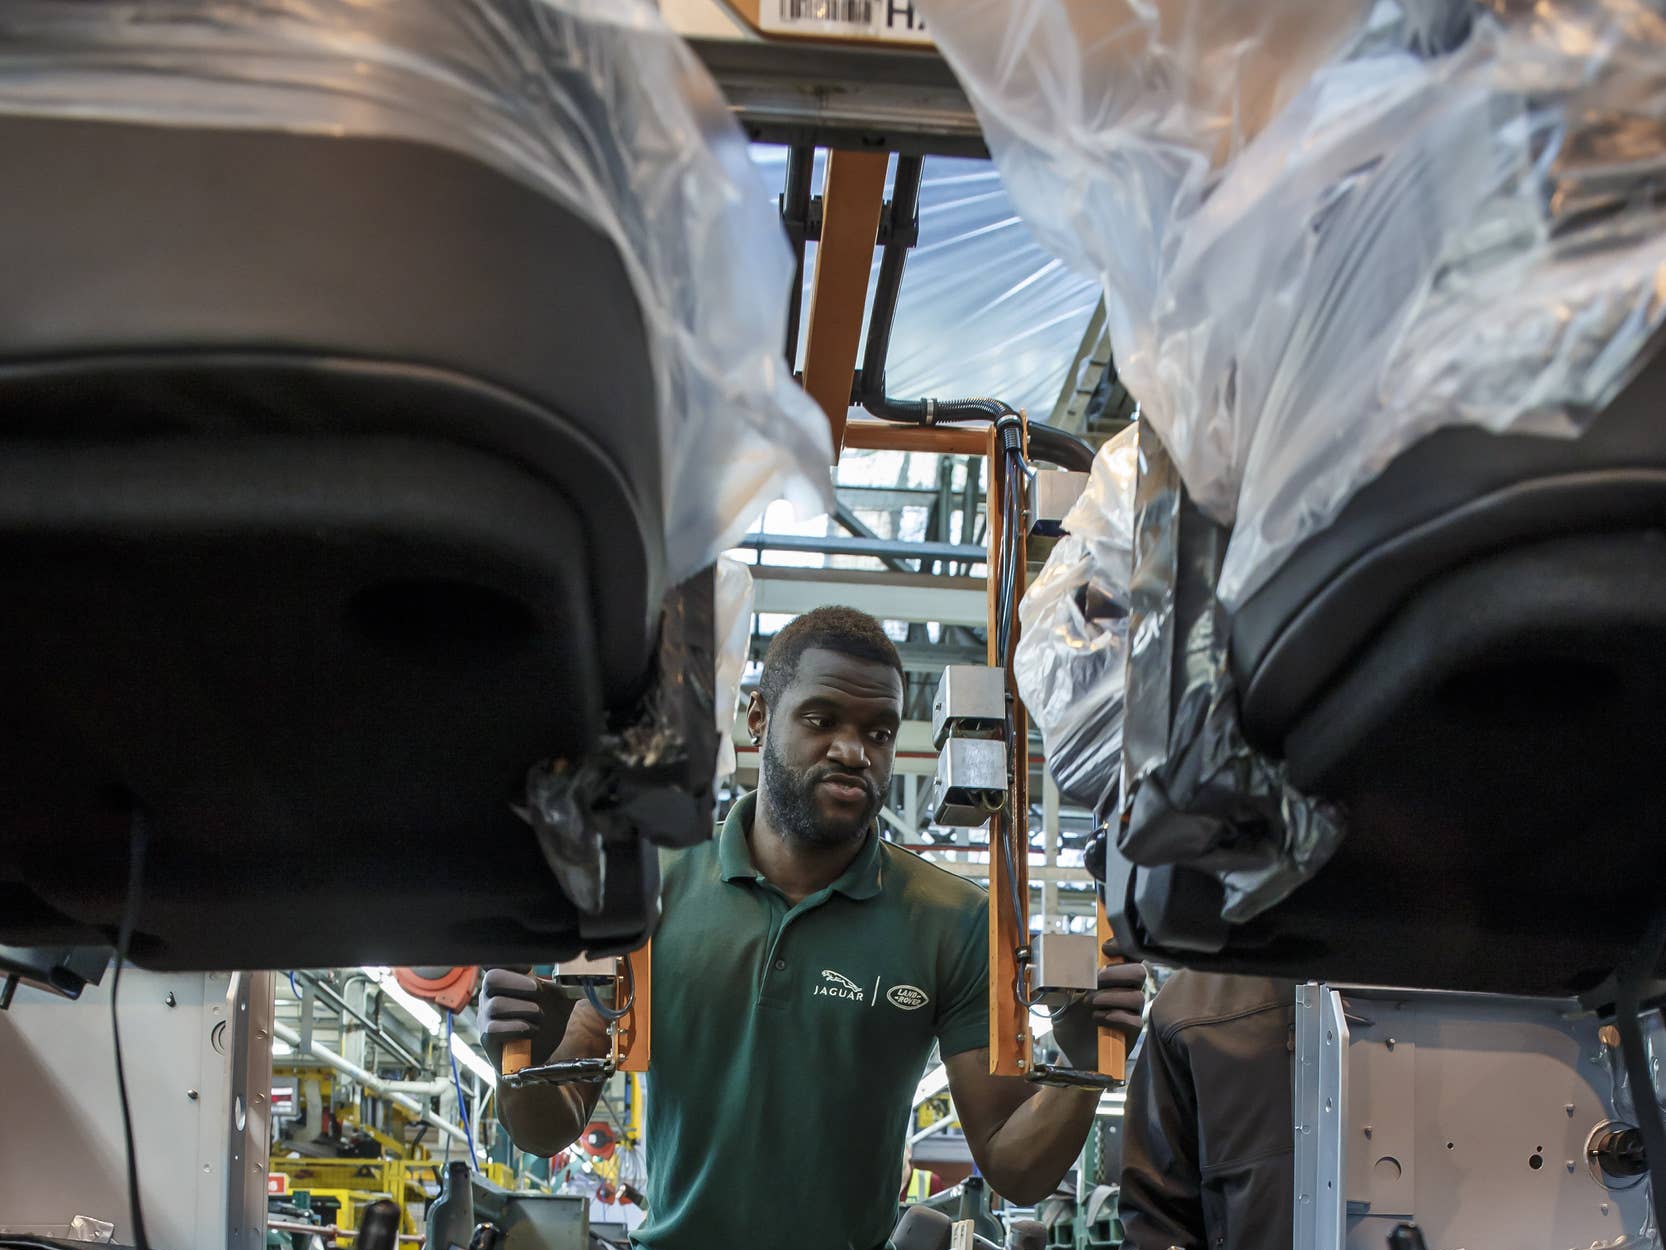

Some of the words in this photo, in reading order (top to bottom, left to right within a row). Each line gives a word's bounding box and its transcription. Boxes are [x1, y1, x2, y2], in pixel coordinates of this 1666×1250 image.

[813, 985, 864, 1001] JAGUAR
[897, 989, 918, 998] LAND
[897, 996, 921, 1006] ROVER
